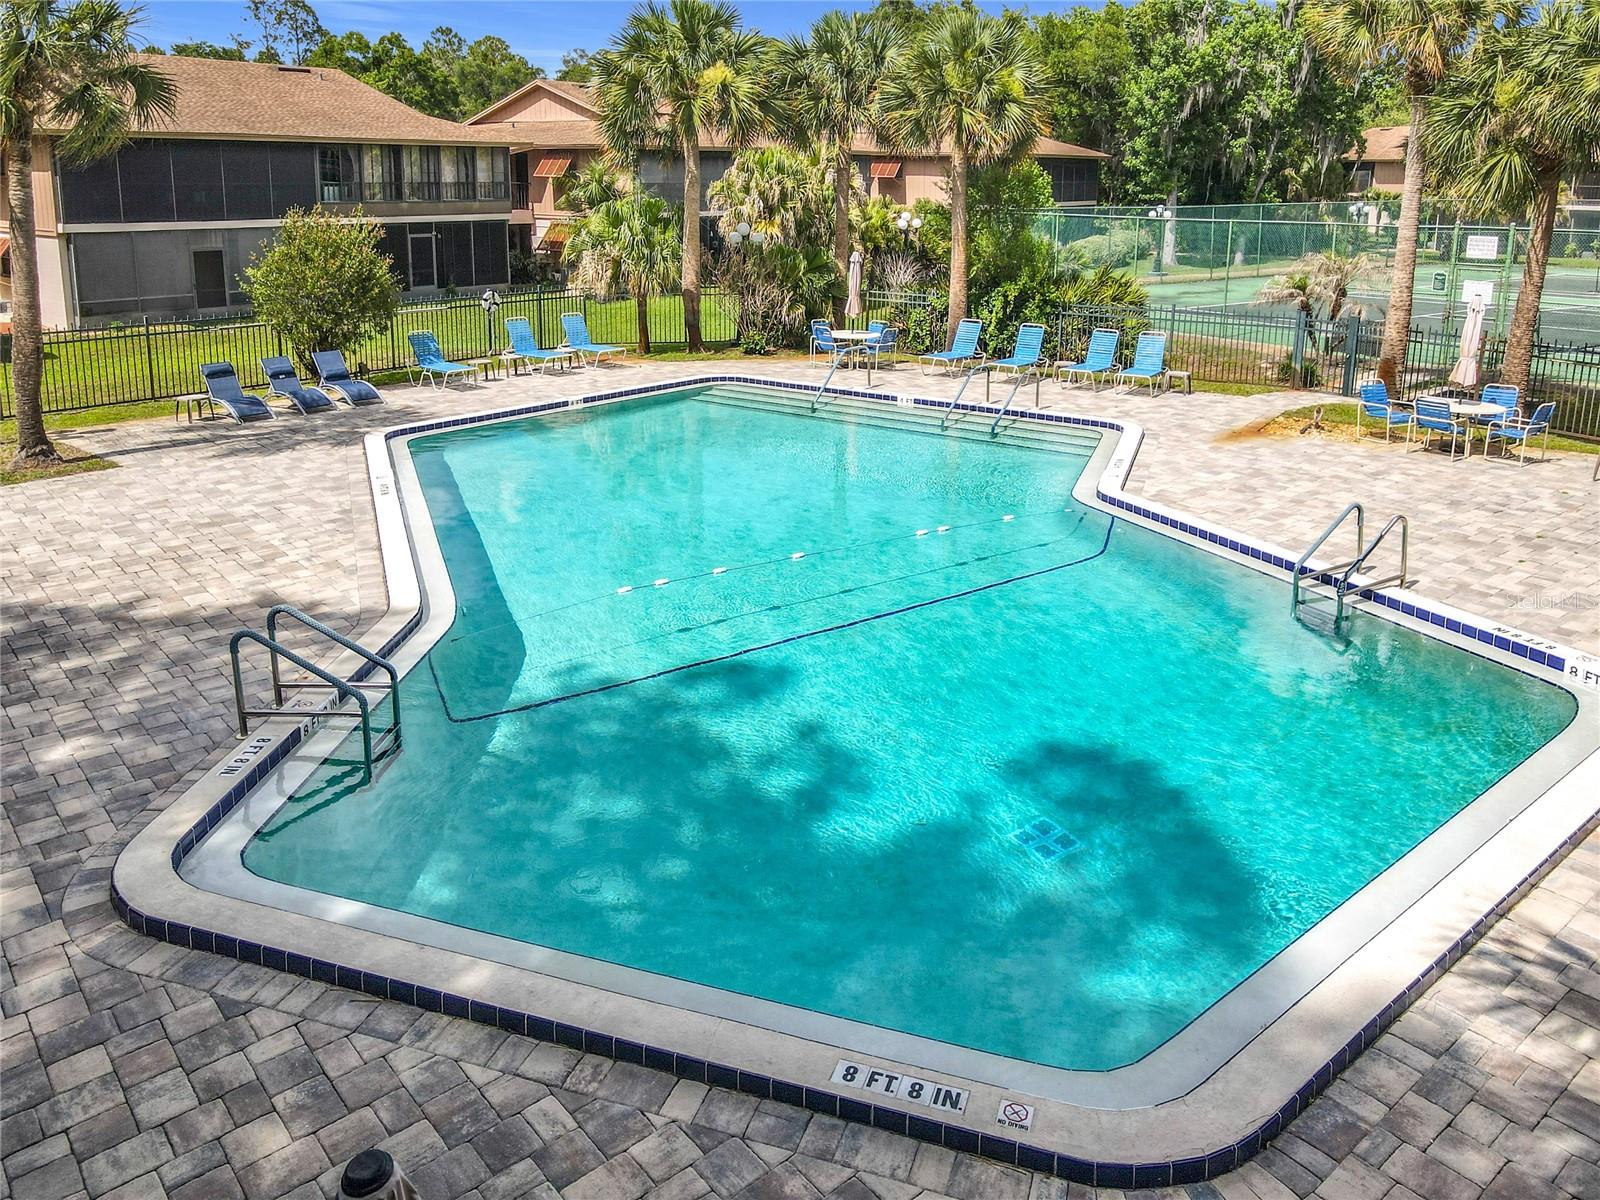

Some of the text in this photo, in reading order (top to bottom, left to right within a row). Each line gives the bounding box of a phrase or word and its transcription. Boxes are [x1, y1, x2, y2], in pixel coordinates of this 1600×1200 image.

[1569, 665, 1578, 677] 8
[303, 724, 309, 737] 8
[842, 1065, 963, 1111] 8 FT. 8 IN.
[1008, 1121, 1029, 1131] DIVING
